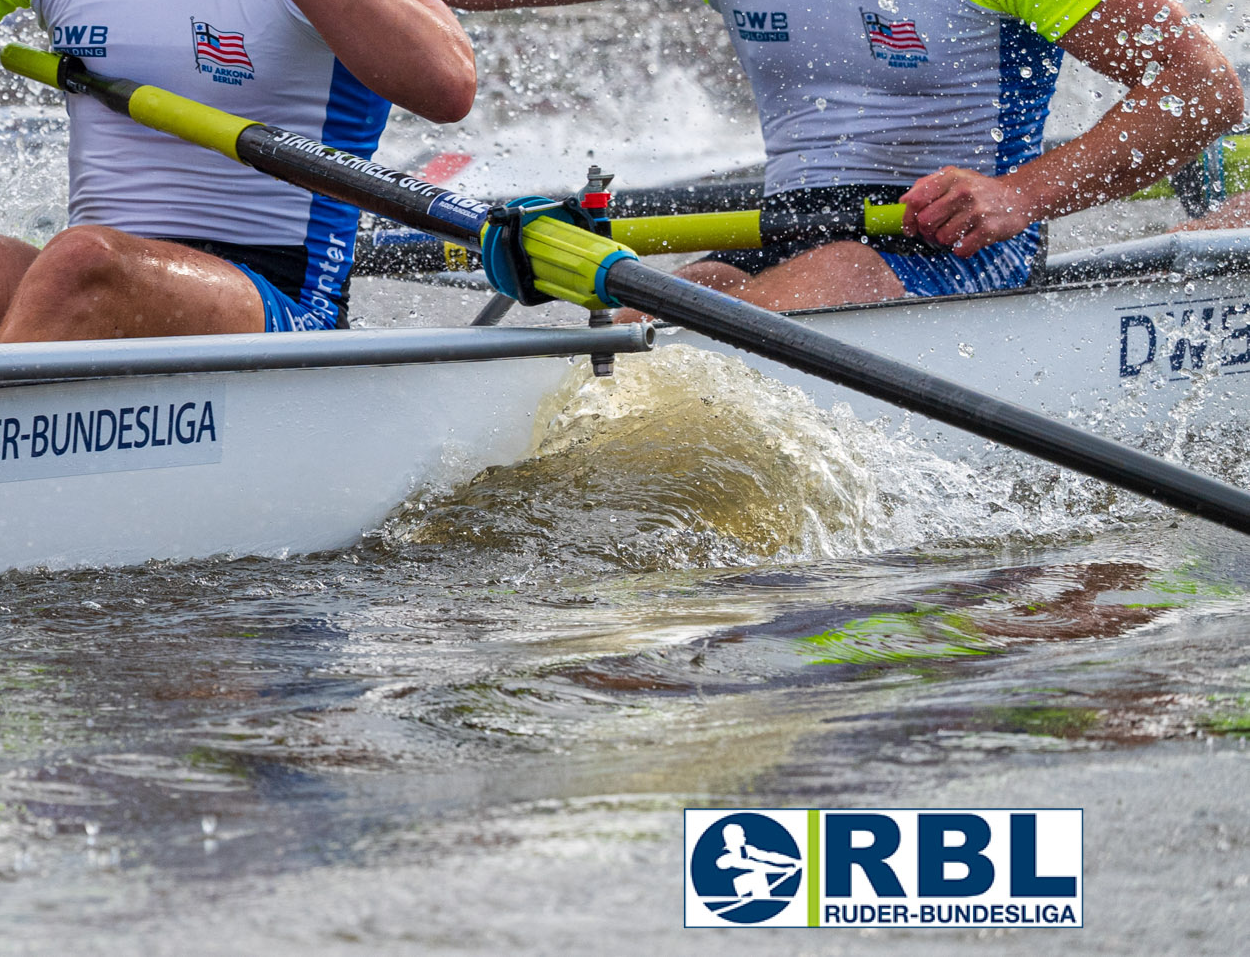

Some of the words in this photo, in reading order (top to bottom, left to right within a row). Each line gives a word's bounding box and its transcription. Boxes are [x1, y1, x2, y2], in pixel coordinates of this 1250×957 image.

[733, 9, 788, 30] DWB
[53, 25, 108, 45] DWB
[201, 64, 213, 73] RU
[215, 67, 255, 80] ARKONA
[213, 74, 243, 86] BERLIN
[325, 150, 397, 184] SCHNELL.
[399, 173, 436, 197] GUT.
